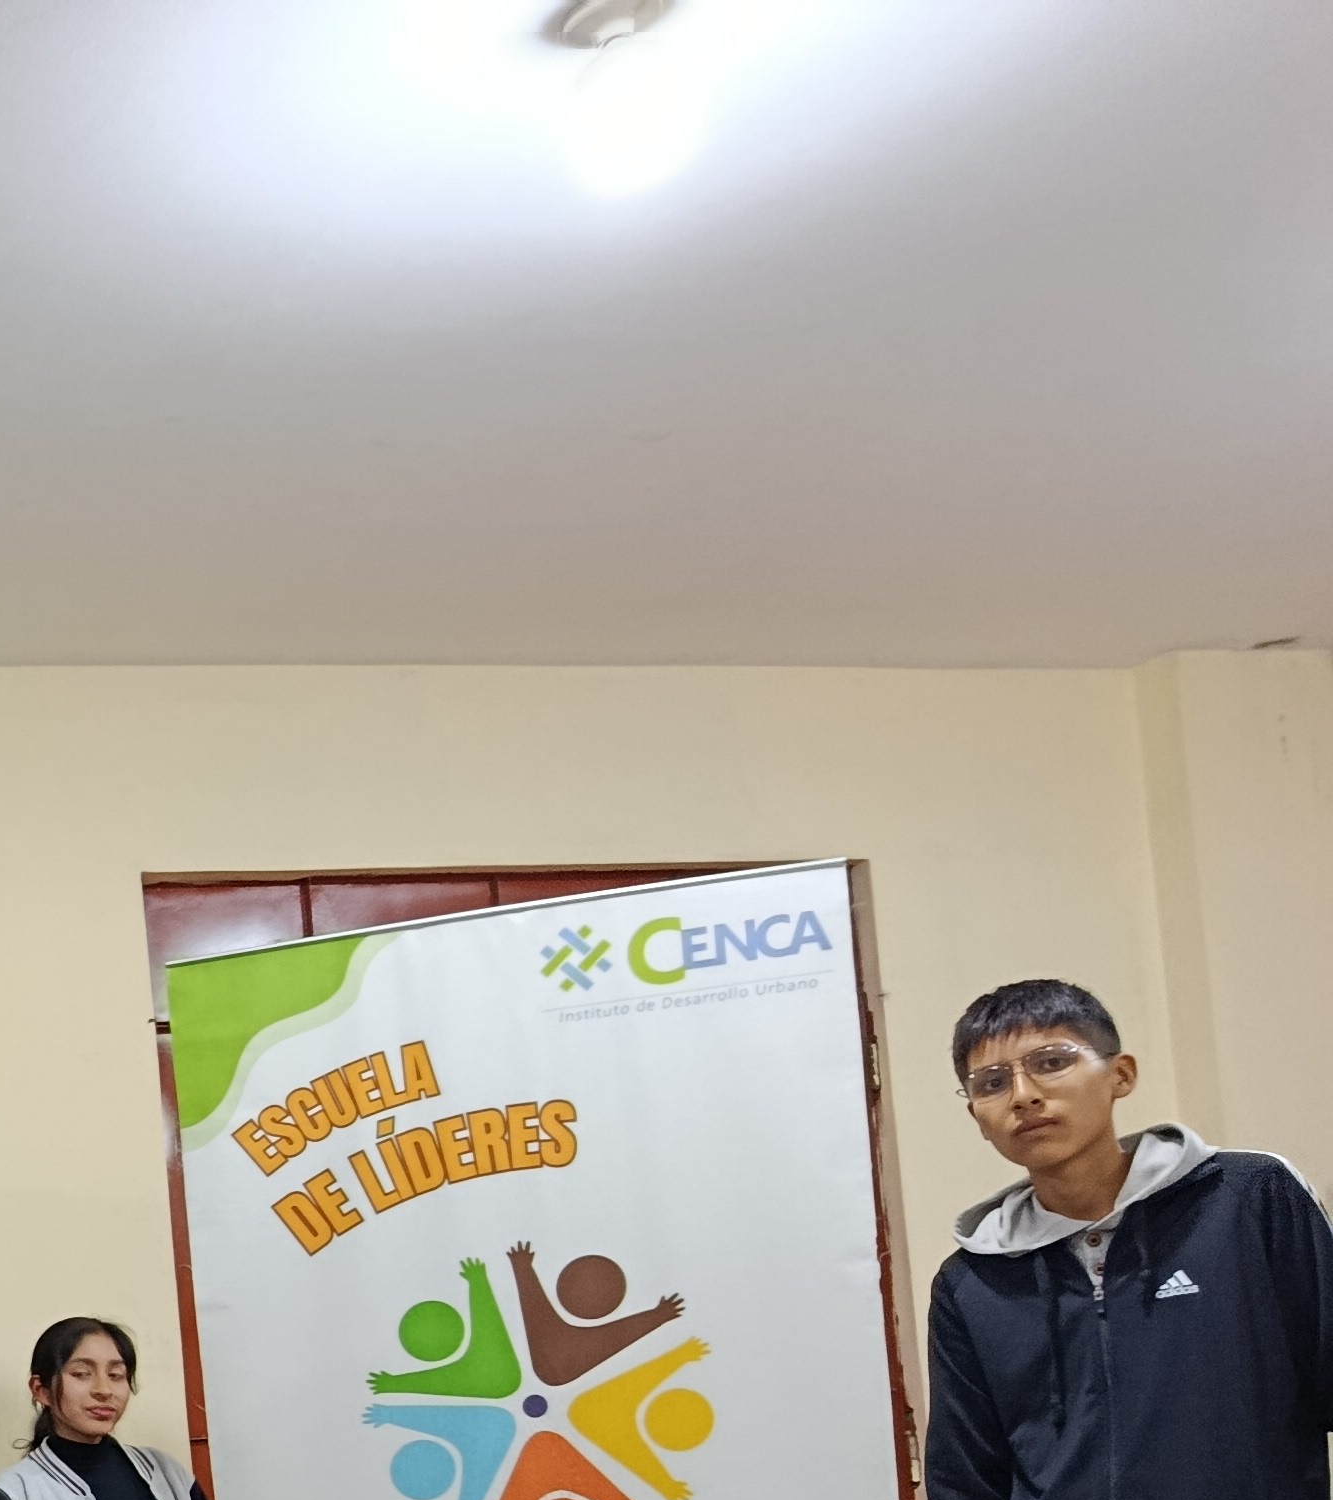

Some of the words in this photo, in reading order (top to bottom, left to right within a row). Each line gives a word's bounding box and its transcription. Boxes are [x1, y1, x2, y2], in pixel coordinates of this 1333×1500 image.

[559, 1003, 630, 1023] Instituto
[636, 999, 656, 1013] de
[661, 986, 749, 1010] Desarrollo
[755, 978, 819, 997] Urbano
[627, 910, 833, 985] CENCA
[232, 1040, 441, 1177] ESCUELA
[271, 1168, 364, 1256] DE
[348, 1099, 577, 1213] LÍDERES
